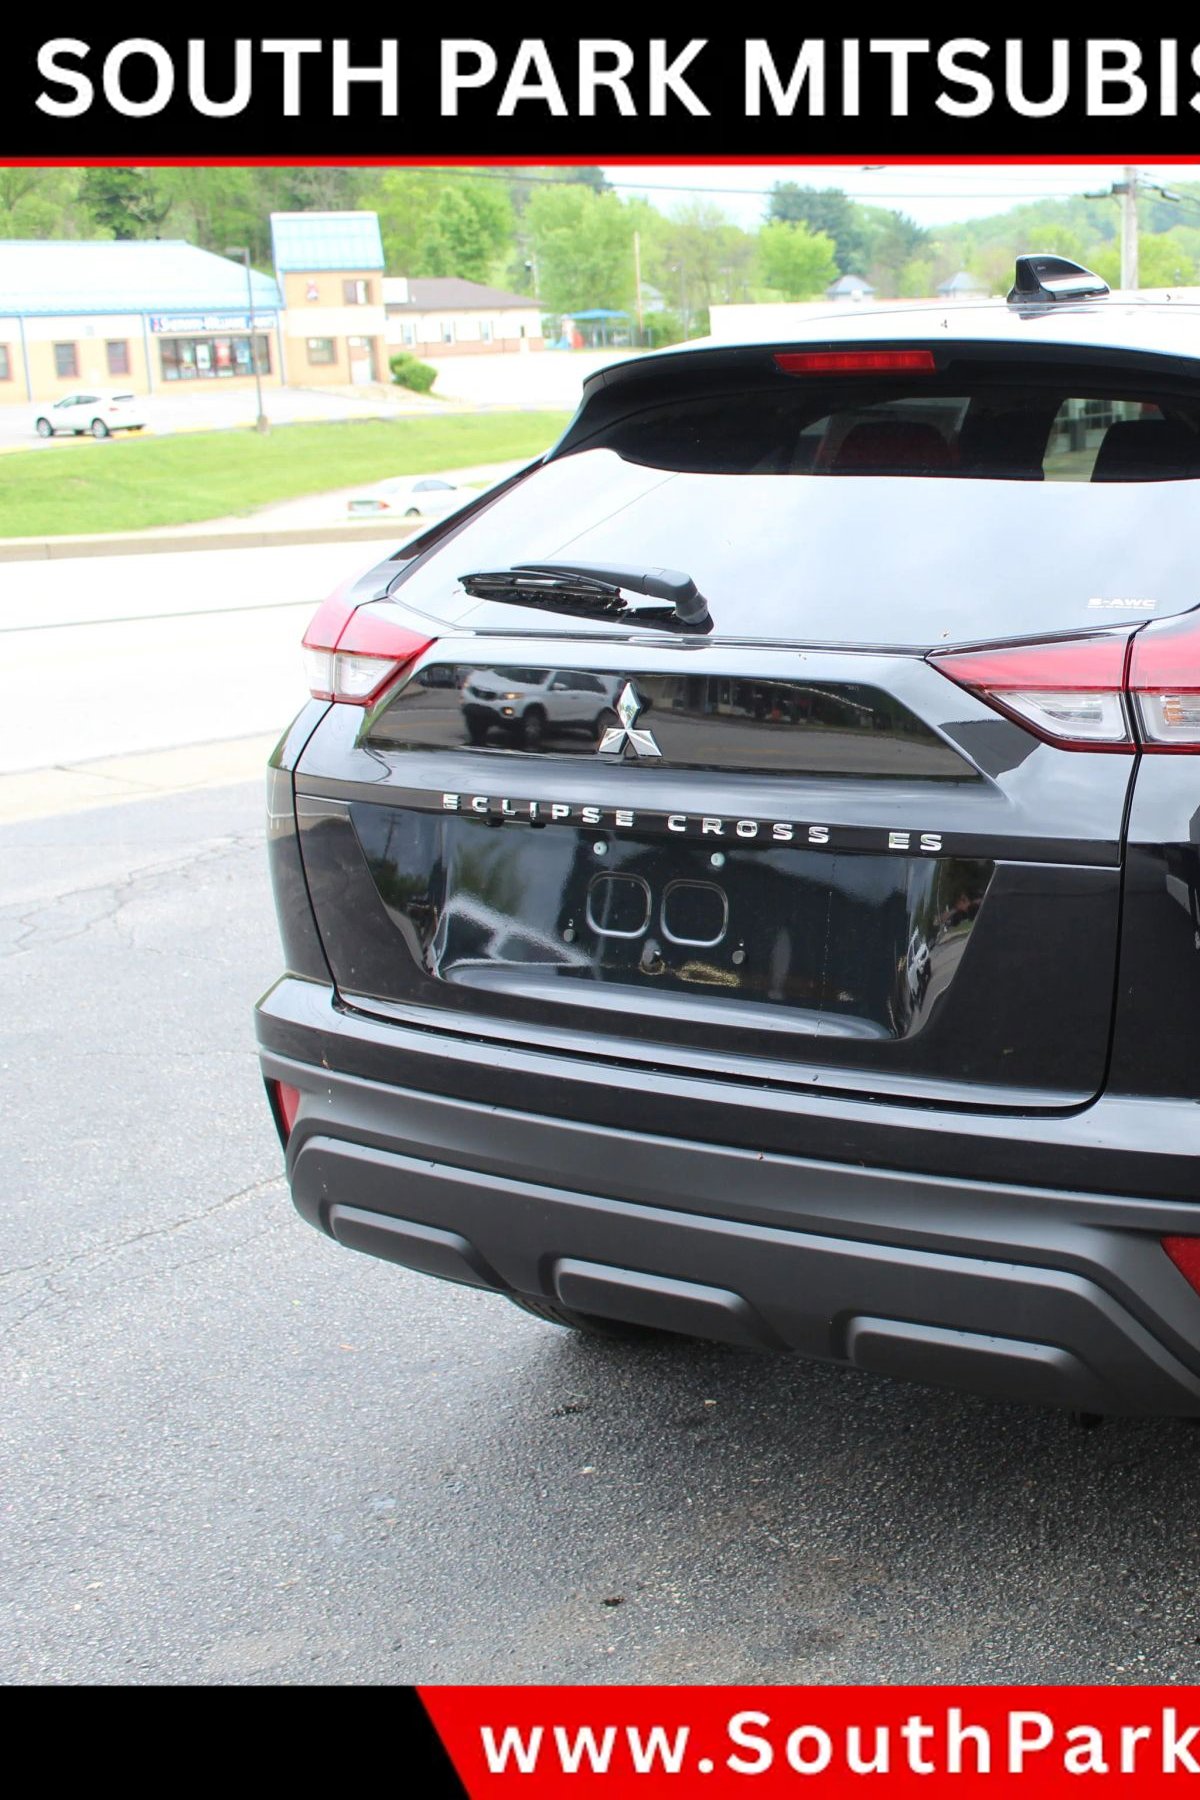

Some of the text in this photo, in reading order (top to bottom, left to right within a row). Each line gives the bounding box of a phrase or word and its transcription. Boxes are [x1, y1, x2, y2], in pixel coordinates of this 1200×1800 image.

[442, 793, 943, 853] ECLIPSE CROSS ES
